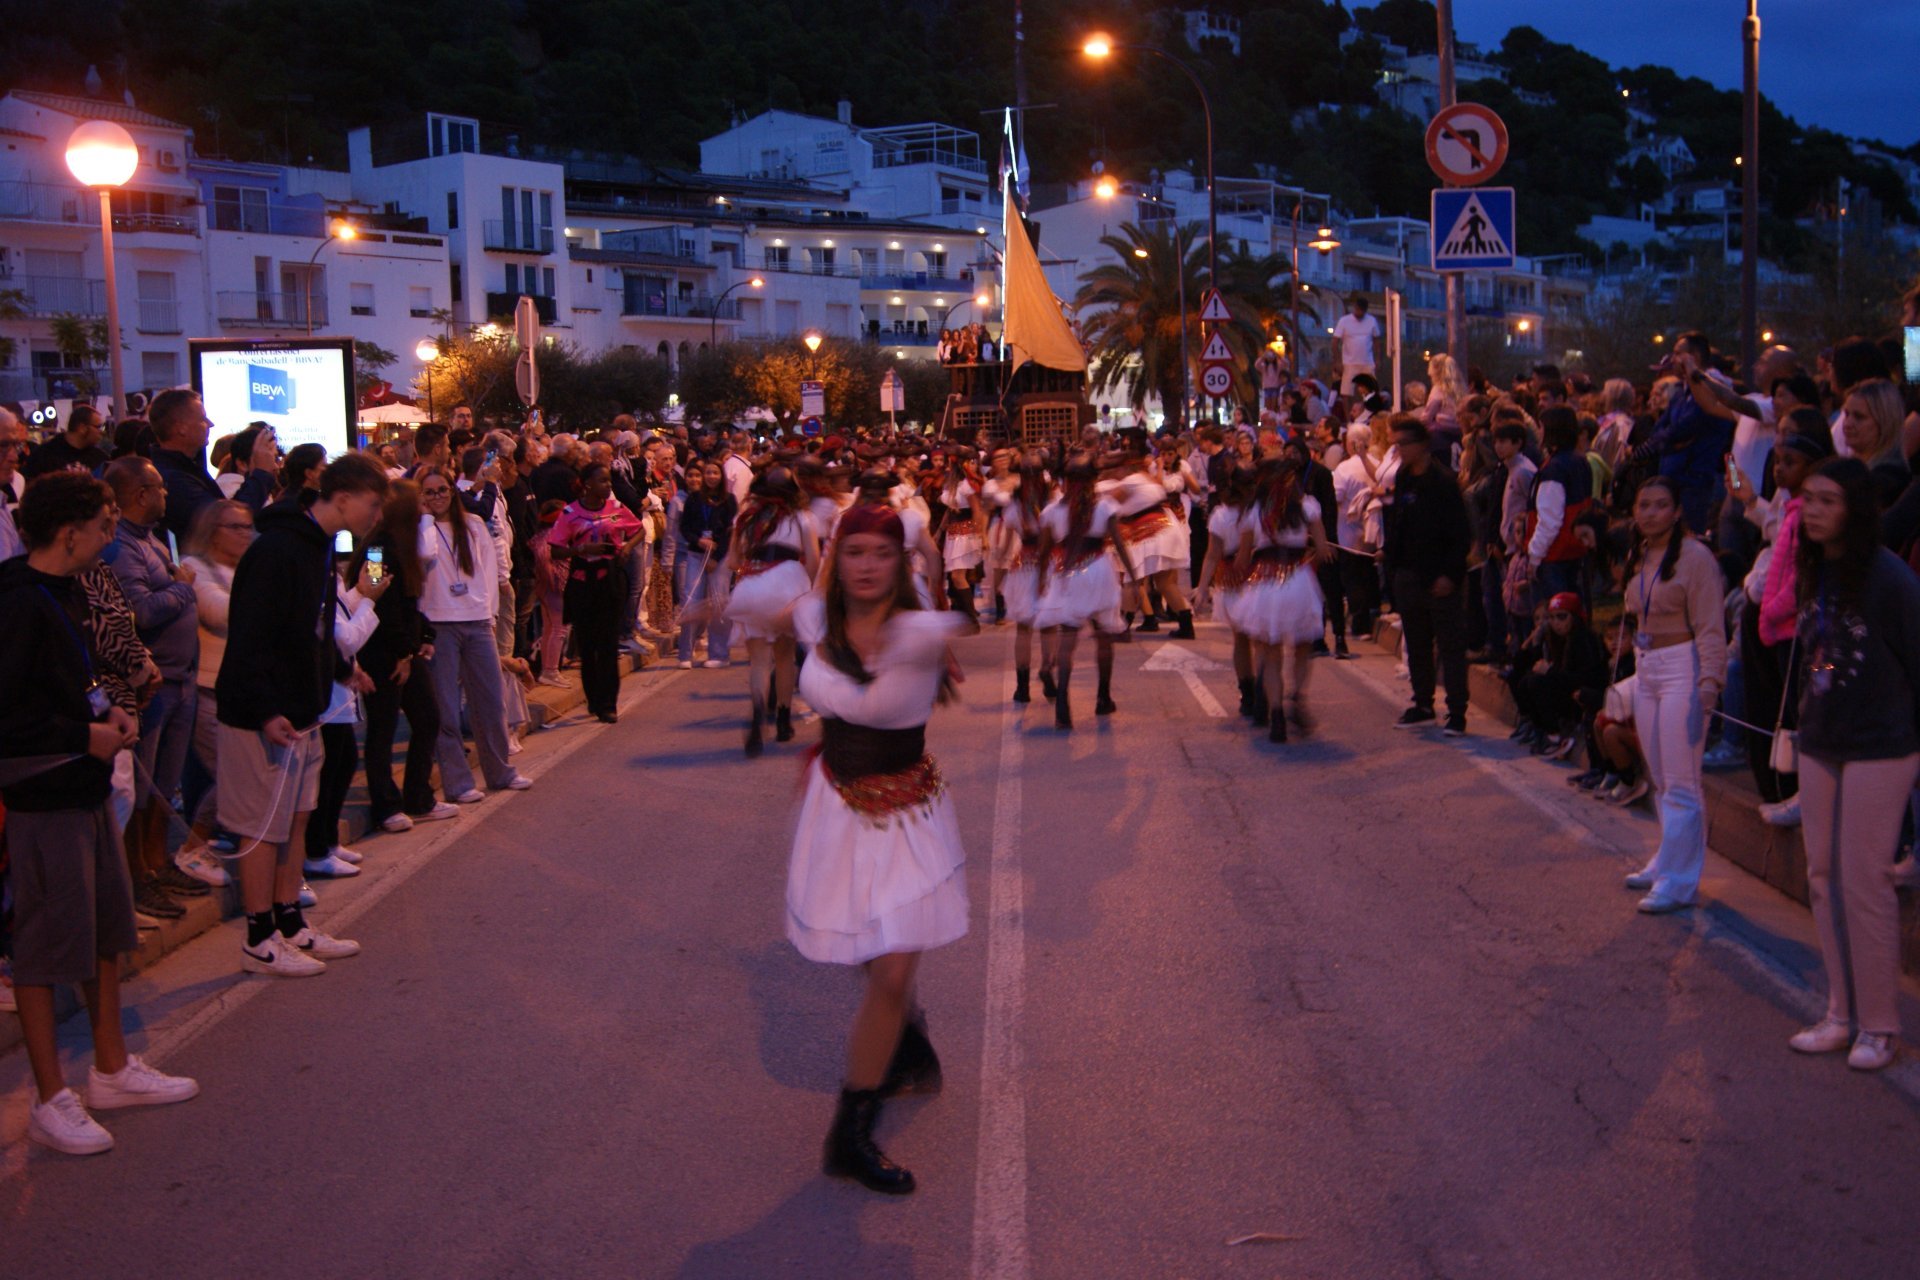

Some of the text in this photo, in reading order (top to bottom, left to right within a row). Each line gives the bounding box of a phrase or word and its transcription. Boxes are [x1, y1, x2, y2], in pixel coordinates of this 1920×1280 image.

[216, 357, 226, 365] de
[250, 356, 288, 365] Sabadell
[1207, 374, 1227, 386] 30
[252, 382, 286, 396] BBVA
